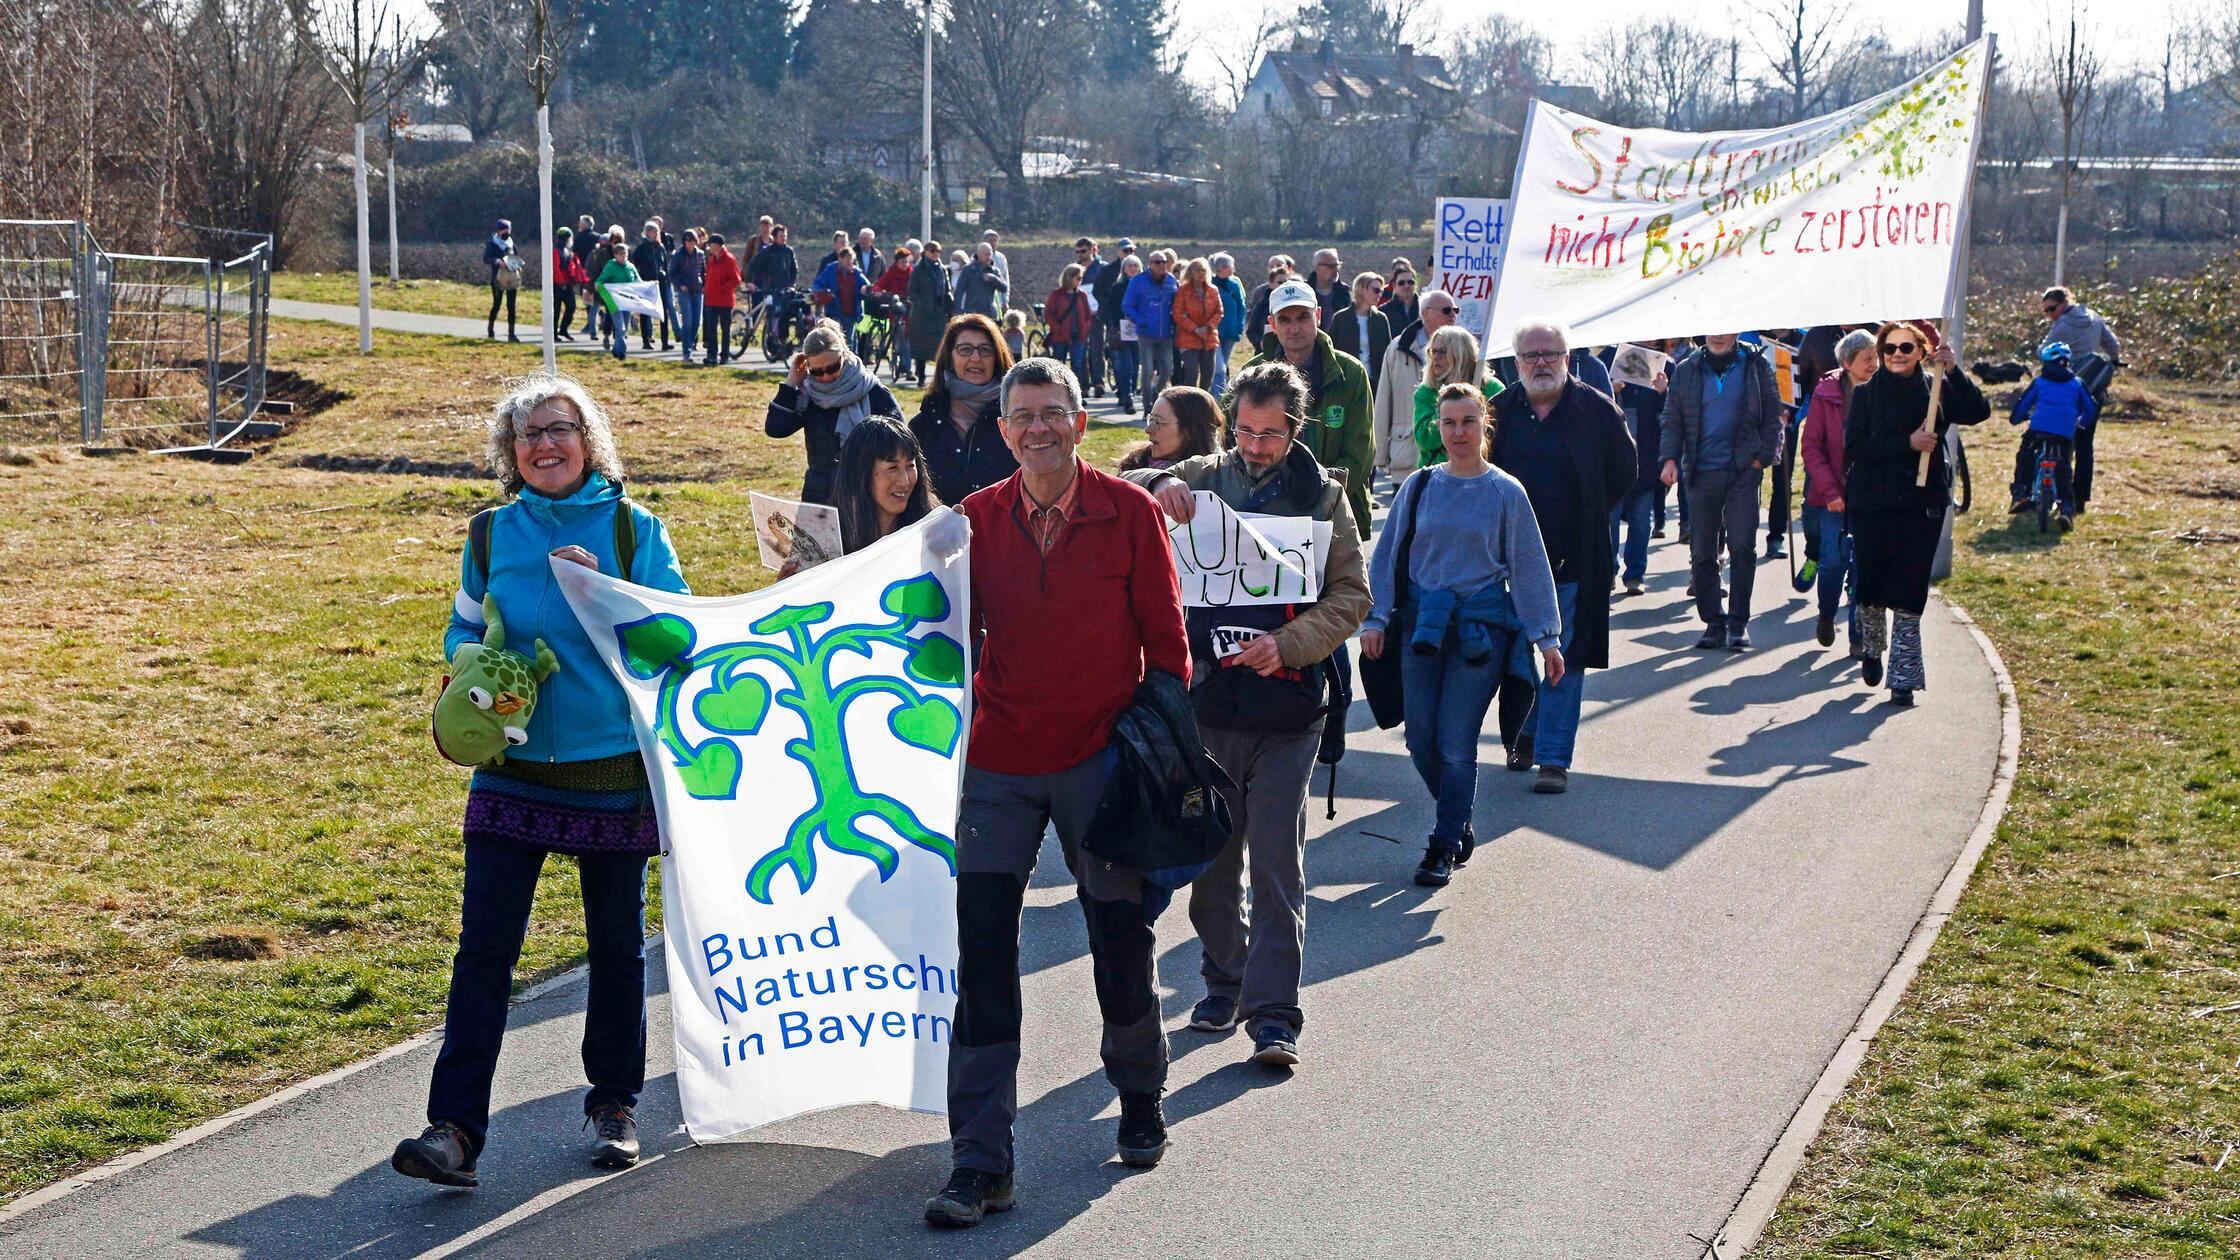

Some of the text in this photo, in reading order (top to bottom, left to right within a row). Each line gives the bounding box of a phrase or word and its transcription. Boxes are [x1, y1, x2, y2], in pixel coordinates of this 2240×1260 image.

[1794, 186, 1952, 253] zerstören
[702, 916, 841, 977] Bund
[721, 1010, 951, 1067] in Bayern
